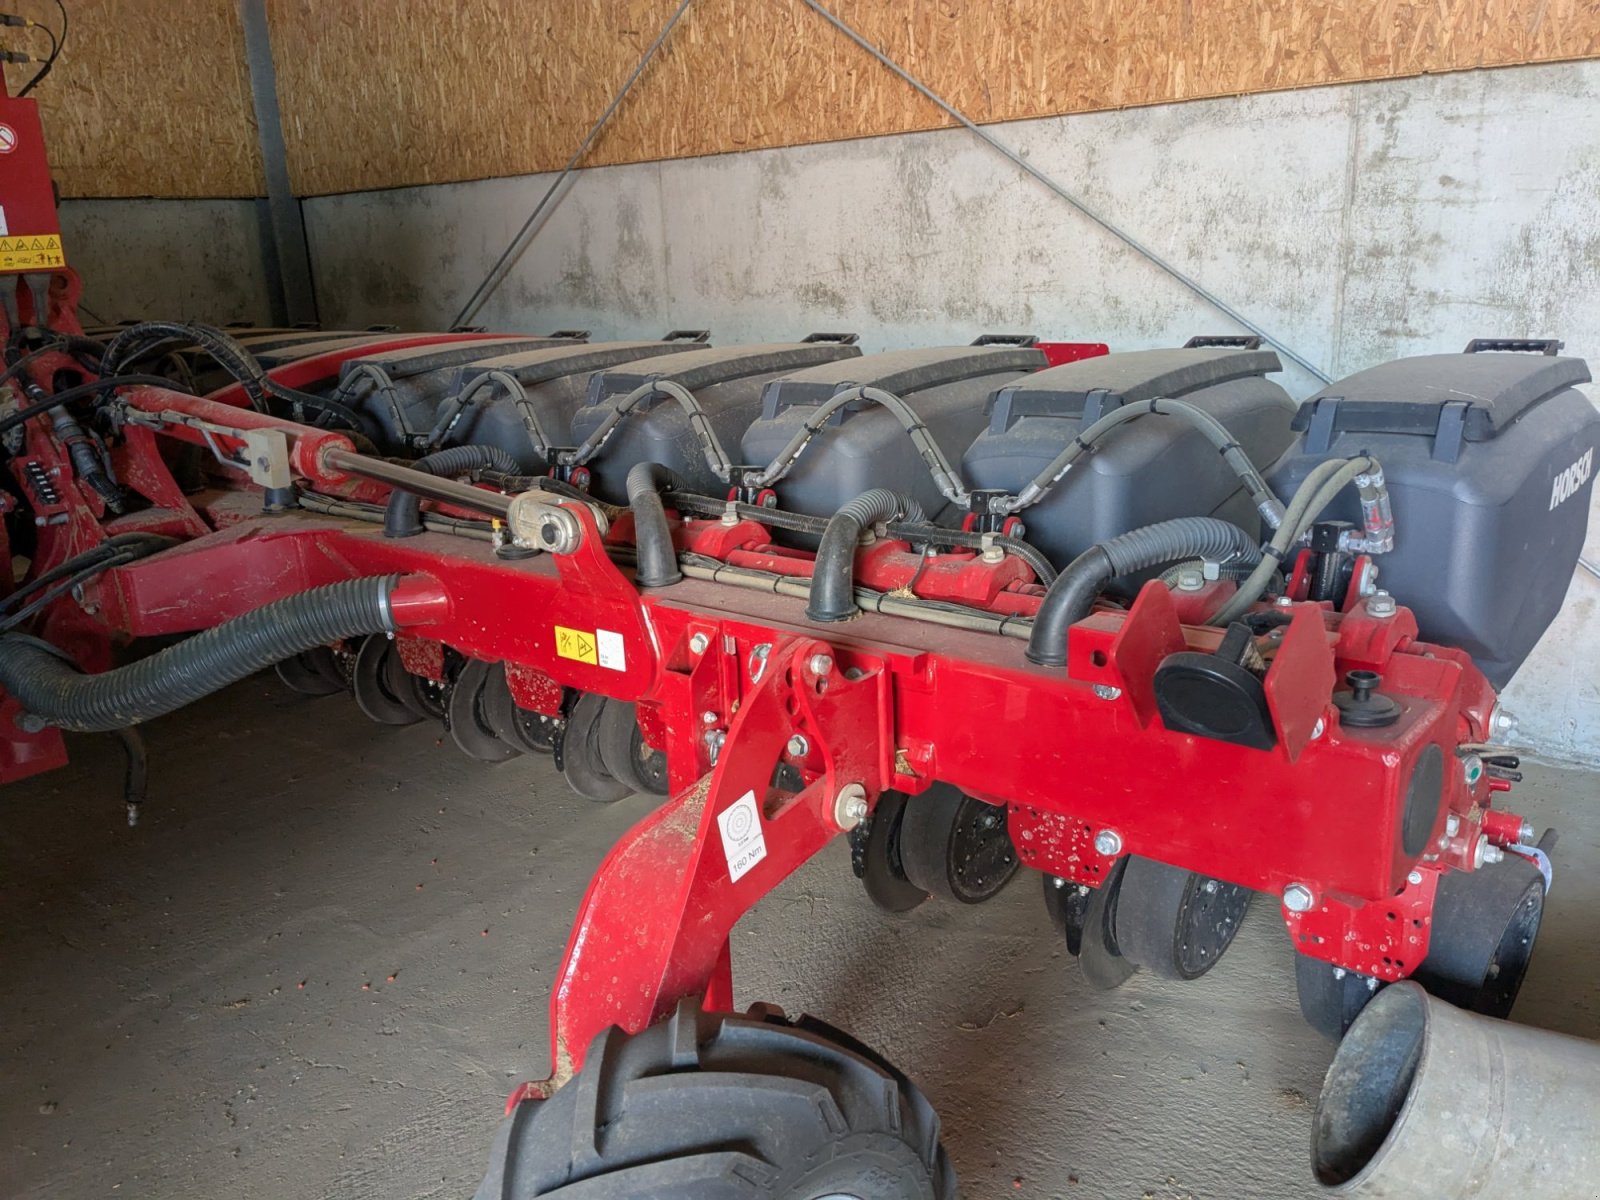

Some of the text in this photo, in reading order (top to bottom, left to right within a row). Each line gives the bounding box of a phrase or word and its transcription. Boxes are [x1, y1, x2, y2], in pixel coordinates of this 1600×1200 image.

[1549, 447, 1593, 511] HORSCH
[733, 846, 762, 873] 160 Nm
